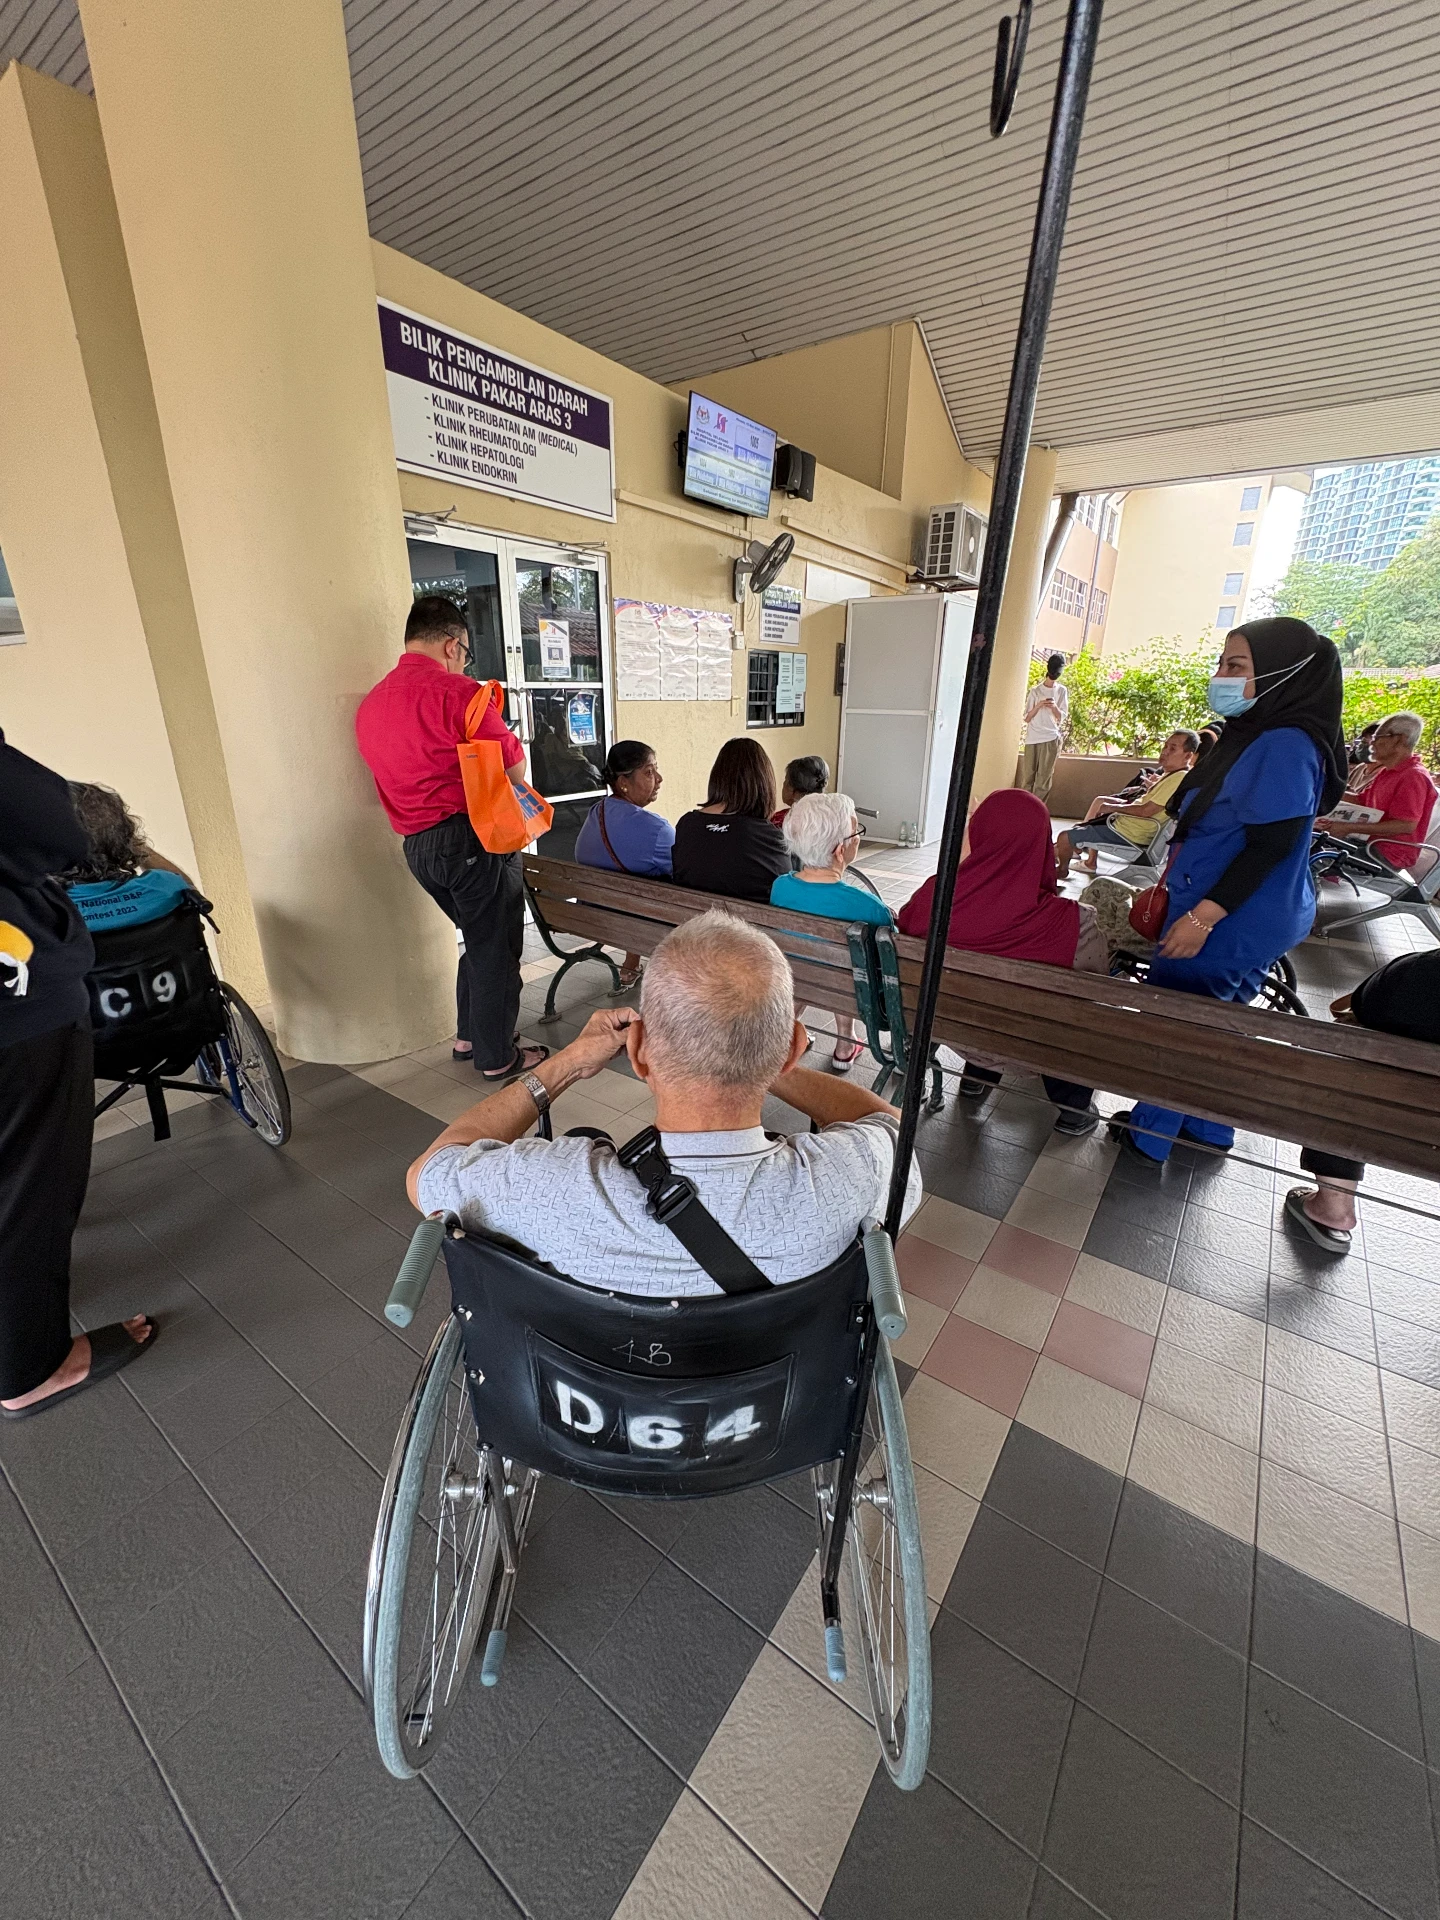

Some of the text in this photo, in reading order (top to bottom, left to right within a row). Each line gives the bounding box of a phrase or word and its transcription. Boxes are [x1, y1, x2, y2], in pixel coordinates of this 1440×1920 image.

[400, 321, 588, 417] BILIK PENGAMBILAN DARAH
[428, 358, 572, 430] KLINIK PAKAR ARAS 3
[431, 393, 465, 417] KLINIK
[467, 406, 521, 436] PERUBATAN
[522, 426, 536, 441] AM
[538, 430, 578, 457] (MEDICAL)
[433, 412, 467, 435] KLINIK
[469, 424, 537, 458] RHEUMATOLOGI
[435, 431, 468, 454] KLINIK
[470, 442, 525, 470] HEPATOLOGI
[437, 450, 470, 471] KLINIK
[472, 460, 518, 484] ENDOKRIN
[81, 896, 121, 909] National
[122, 891, 143, 902] B&P
[82, 905, 138, 921] ontest 2023
